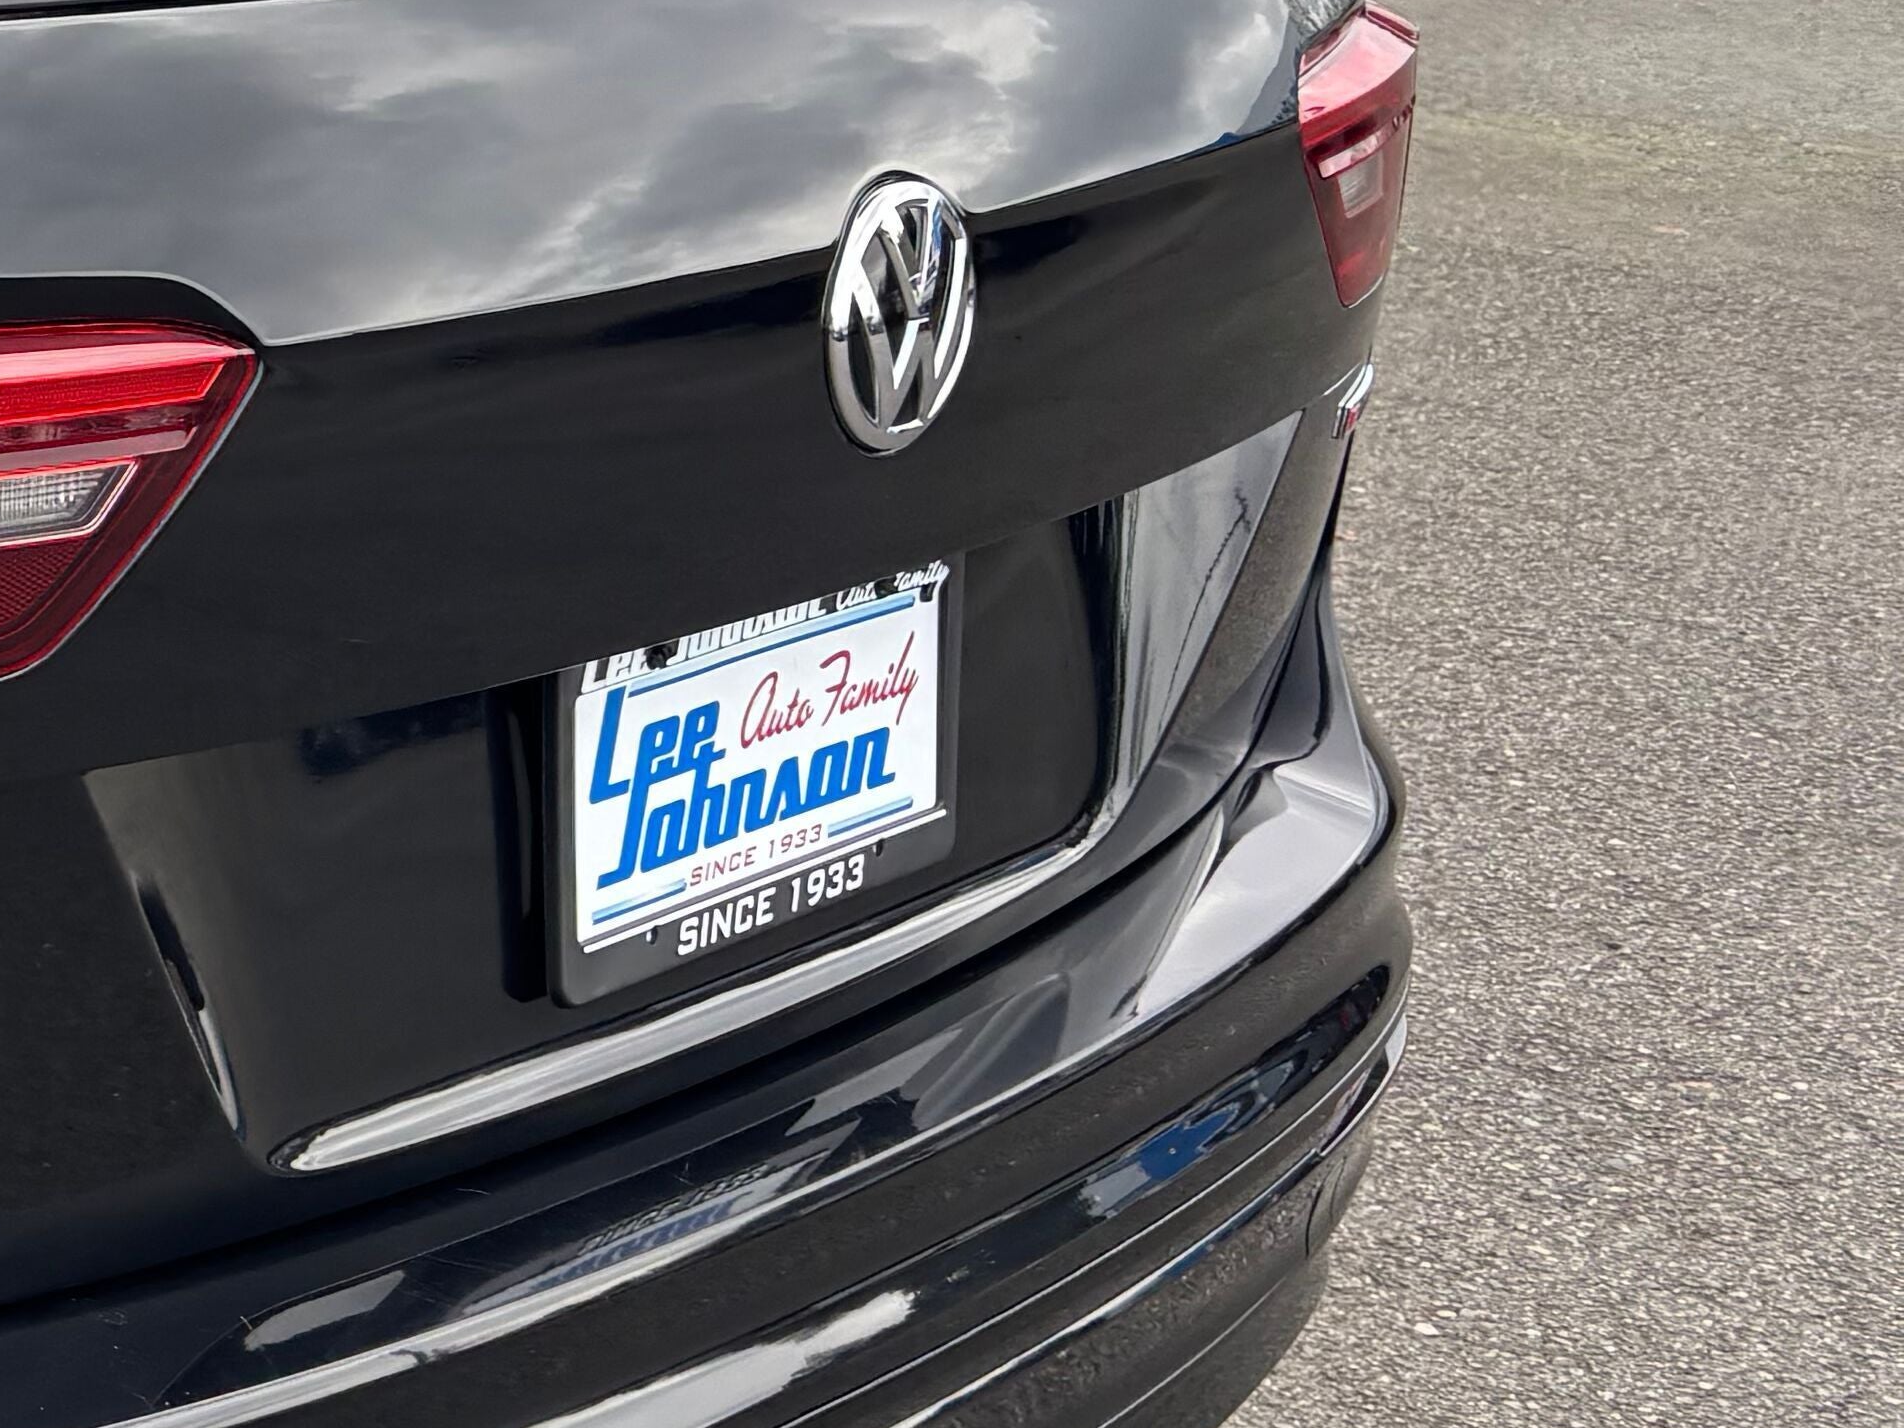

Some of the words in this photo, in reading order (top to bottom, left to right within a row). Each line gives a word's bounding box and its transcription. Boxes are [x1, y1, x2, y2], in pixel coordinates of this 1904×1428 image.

[589, 685, 726, 805] Lee
[740, 671, 815, 749] Auto
[819, 630, 919, 726] Family
[596, 726, 896, 891] Johnson
[689, 845, 758, 887] SINCE
[768, 823, 823, 859] 1933
[678, 885, 776, 956] SINCE
[791, 852, 865, 914] 1933
